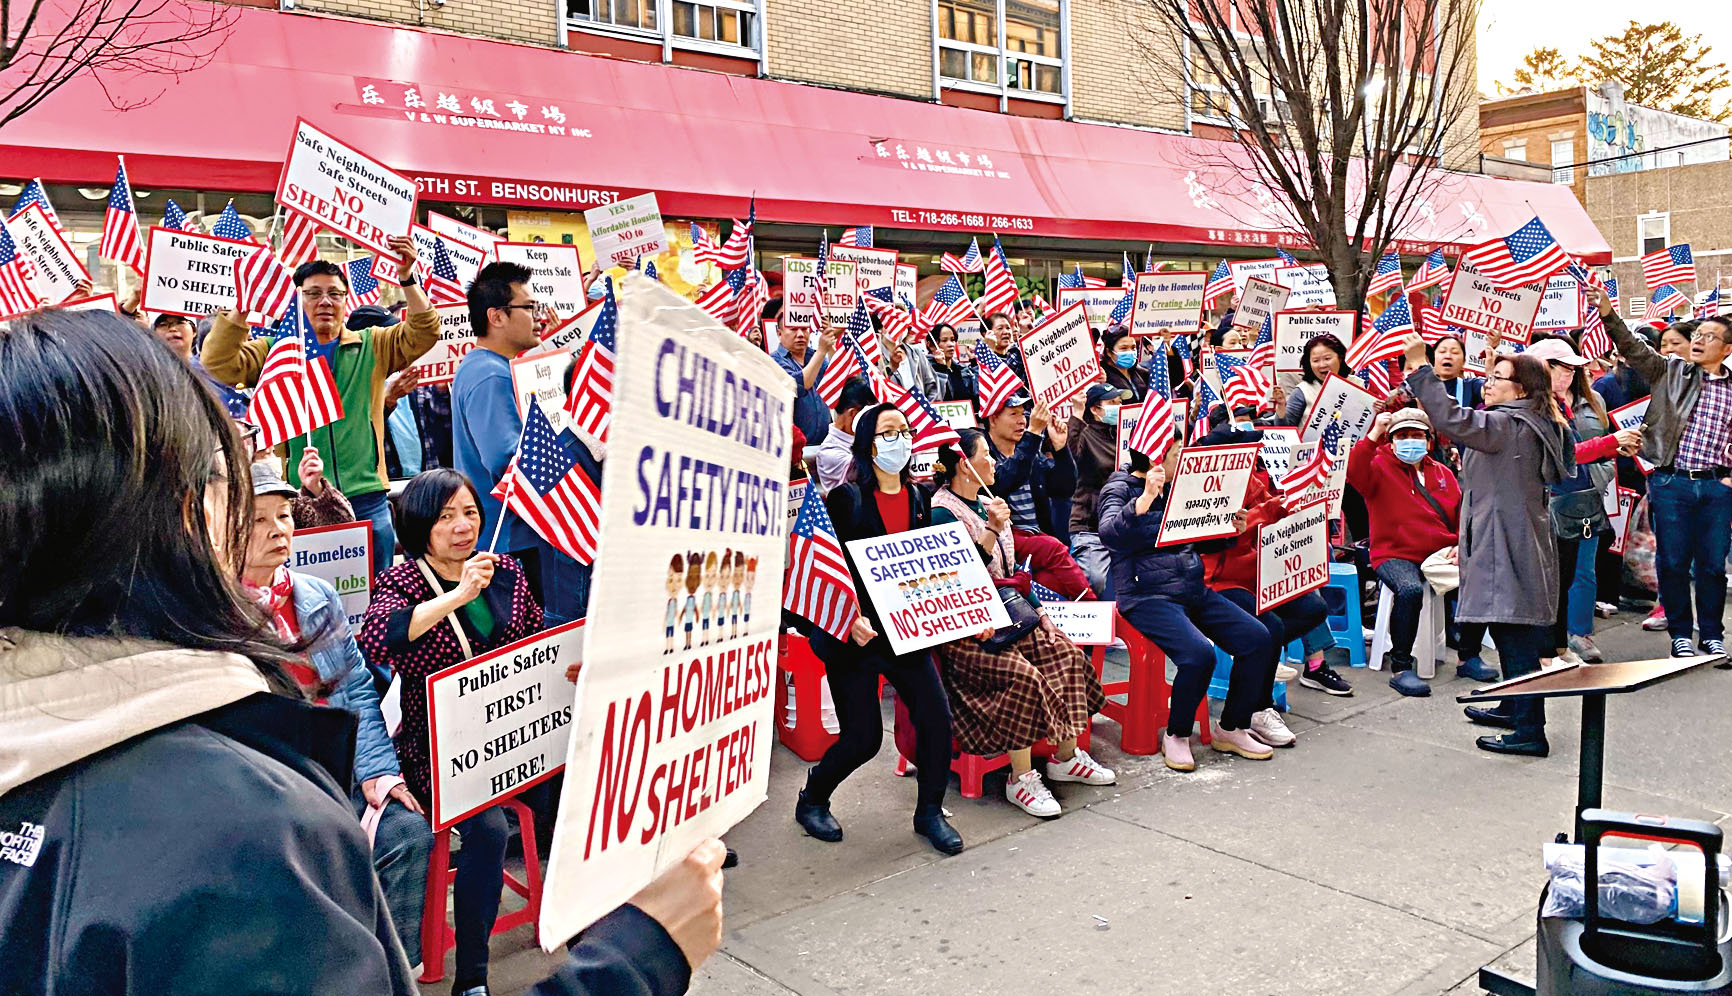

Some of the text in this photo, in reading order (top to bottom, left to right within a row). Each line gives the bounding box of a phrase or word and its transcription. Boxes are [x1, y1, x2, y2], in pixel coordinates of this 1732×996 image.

[404, 112, 592, 138] V & W SUPERMARKET NY INC
[297, 130, 413, 202] Safe Neighborhoods
[318, 161, 388, 206] Safe Streets
[455, 180, 482, 196] ST.
[491, 182, 620, 206] BENSONHURST
[332, 186, 364, 214] NO
[608, 204, 626, 216] YES
[592, 212, 660, 238] Affordable Housing
[891, 210, 916, 222] TEL:
[918, 212, 984, 227] 718-266-1668
[992, 216, 1033, 230] 266-1633
[458, 226, 477, 240] Keep
[618, 229, 644, 241] NO to
[22, 211, 38, 232] Safe
[37, 229, 79, 288] Neighborhoods
[170, 236, 208, 252] Public
[413, 233, 479, 266] Neigrhoods
[21, 235, 37, 258] Safe
[34, 254, 58, 284] Streets
[526, 249, 548, 262] Keep
[848, 254, 895, 266] Neighborhoods
[188, 260, 232, 276] FIRST!
[531, 266, 572, 276] treets Safe
[788, 261, 854, 276] KIDS AFETY
[860, 268, 882, 276] Streets
[1460, 262, 1478, 274] Safe
[157, 276, 237, 298] NO SHELTE
[532, 283, 554, 296] Keep
[1140, 282, 1204, 293] Help the Homeless
[1472, 280, 1490, 293] Safe
[1544, 292, 1563, 300] eally
[554, 300, 574, 312] Away
[790, 292, 853, 306] NO SELTER
[1138, 299, 1201, 312] By Creating Jobs
[1256, 296, 1270, 305] FIRST
[1479, 297, 1502, 314] NO
[790, 311, 812, 323] Near
[1134, 318, 1198, 329] Not building shelters
[1288, 316, 1340, 326] Public Safety
[1446, 304, 1528, 338] SHELTERS!
[1536, 318, 1566, 326] omeless
[438, 330, 454, 340] afe
[552, 326, 582, 349] Keep
[1024, 313, 1086, 360] Safe Neighborhoods
[1040, 336, 1078, 366] Safe Streets
[1282, 346, 1294, 354] NO
[535, 364, 552, 380] Keep
[1052, 356, 1072, 379] NO
[538, 386, 558, 402] Streets
[655, 338, 785, 458] CHILDREN'S
[1334, 392, 1348, 410] Safe
[1310, 407, 1328, 430] Keep
[1355, 406, 1372, 432] Away
[1272, 432, 1286, 442] City
[1264, 446, 1290, 454] BILLIO
[912, 462, 930, 472] ear
[1180, 452, 1254, 476] SHELTERS!
[633, 445, 783, 538] SAFETY FIRST!
[1204, 475, 1225, 493] NO
[1185, 496, 1230, 510] Safe Streets
[1164, 512, 1239, 532] afe Neighborhoods
[1261, 512, 1326, 548] Safe Neighborhoods
[296, 545, 366, 566] Homeless
[865, 530, 960, 562] CHILDREN'S
[1274, 535, 1313, 558] Safe Streets
[870, 548, 974, 582] SAFETY FIRST!
[1284, 554, 1302, 576] NO
[334, 574, 366, 592] Jobs
[1262, 562, 1326, 604] SHELTERS!
[911, 586, 992, 618] HOMELESS
[889, 608, 920, 640] NO
[922, 606, 992, 637] SHELTER!
[458, 643, 560, 698] Public Safety
[656, 639, 772, 744] HOMELESS
[484, 682, 542, 724] FIRST!
[450, 706, 572, 777] NO SHELTERS
[490, 754, 546, 796] HERE!
[584, 690, 652, 862] NO
[641, 720, 757, 846] SHELTER!
